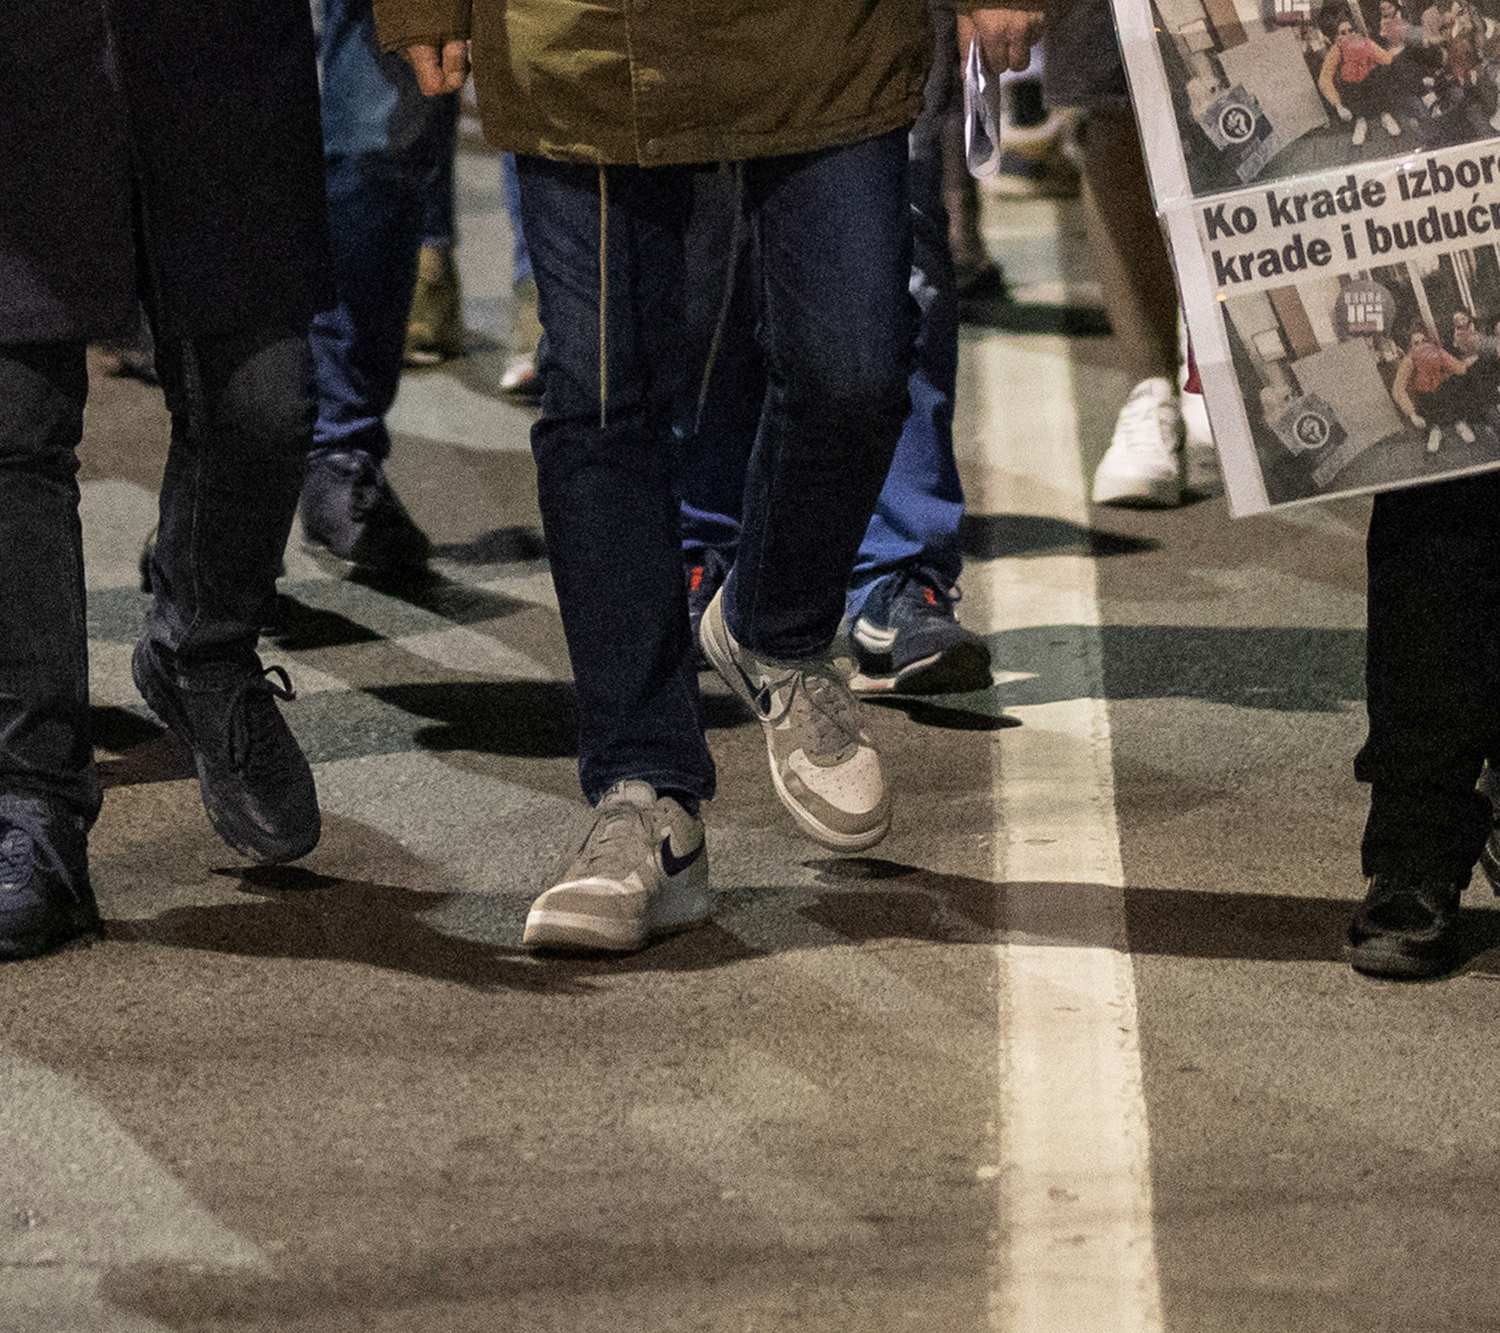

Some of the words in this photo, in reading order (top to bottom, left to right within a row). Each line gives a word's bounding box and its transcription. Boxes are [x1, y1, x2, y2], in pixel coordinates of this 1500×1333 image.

[1202, 203, 1258, 242] Ko
[1266, 174, 1387, 228] krade
[1211, 233, 1333, 287] krade
[1341, 224, 1358, 260] i
